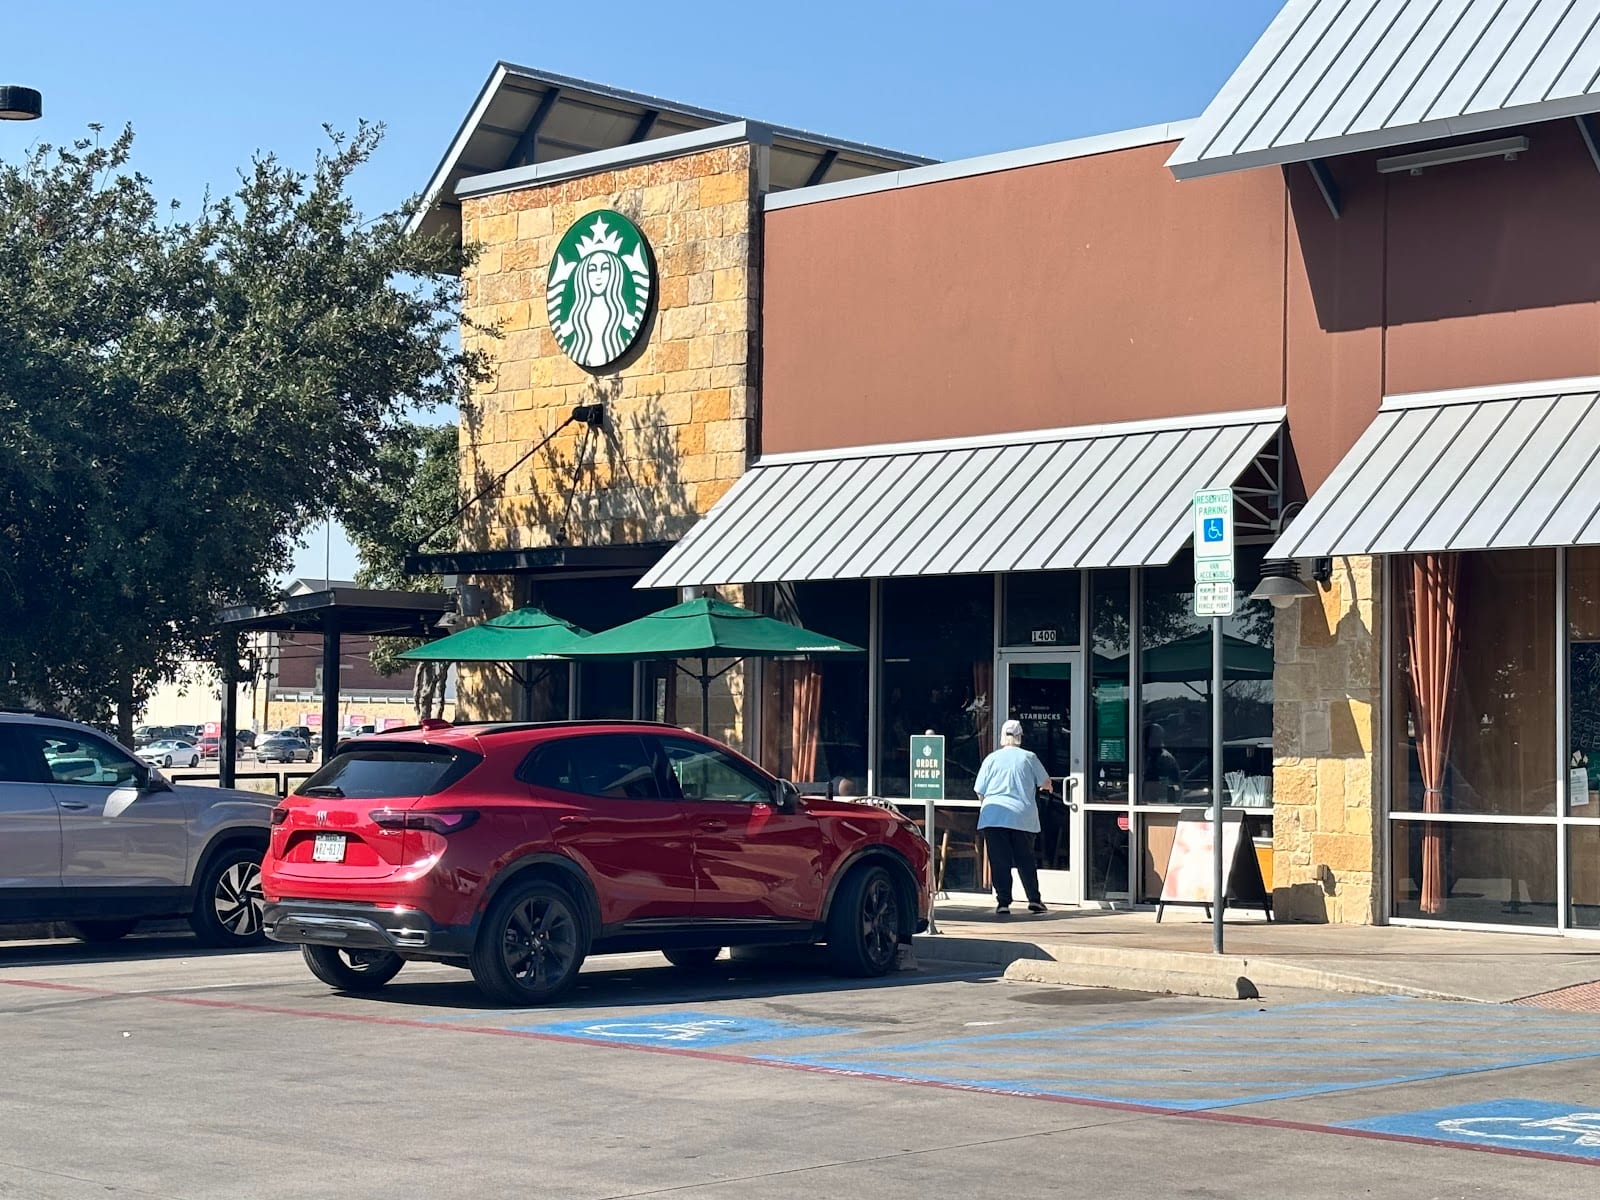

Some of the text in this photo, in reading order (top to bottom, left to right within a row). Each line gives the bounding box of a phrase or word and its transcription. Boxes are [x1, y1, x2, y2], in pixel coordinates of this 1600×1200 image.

[1197, 494, 1229, 504] RESERVED
[1198, 506, 1227, 516] PARKING
[1033, 631, 1055, 641] 1400
[916, 758, 938, 768] ORDER
[914, 769, 941, 779] PICK UP
